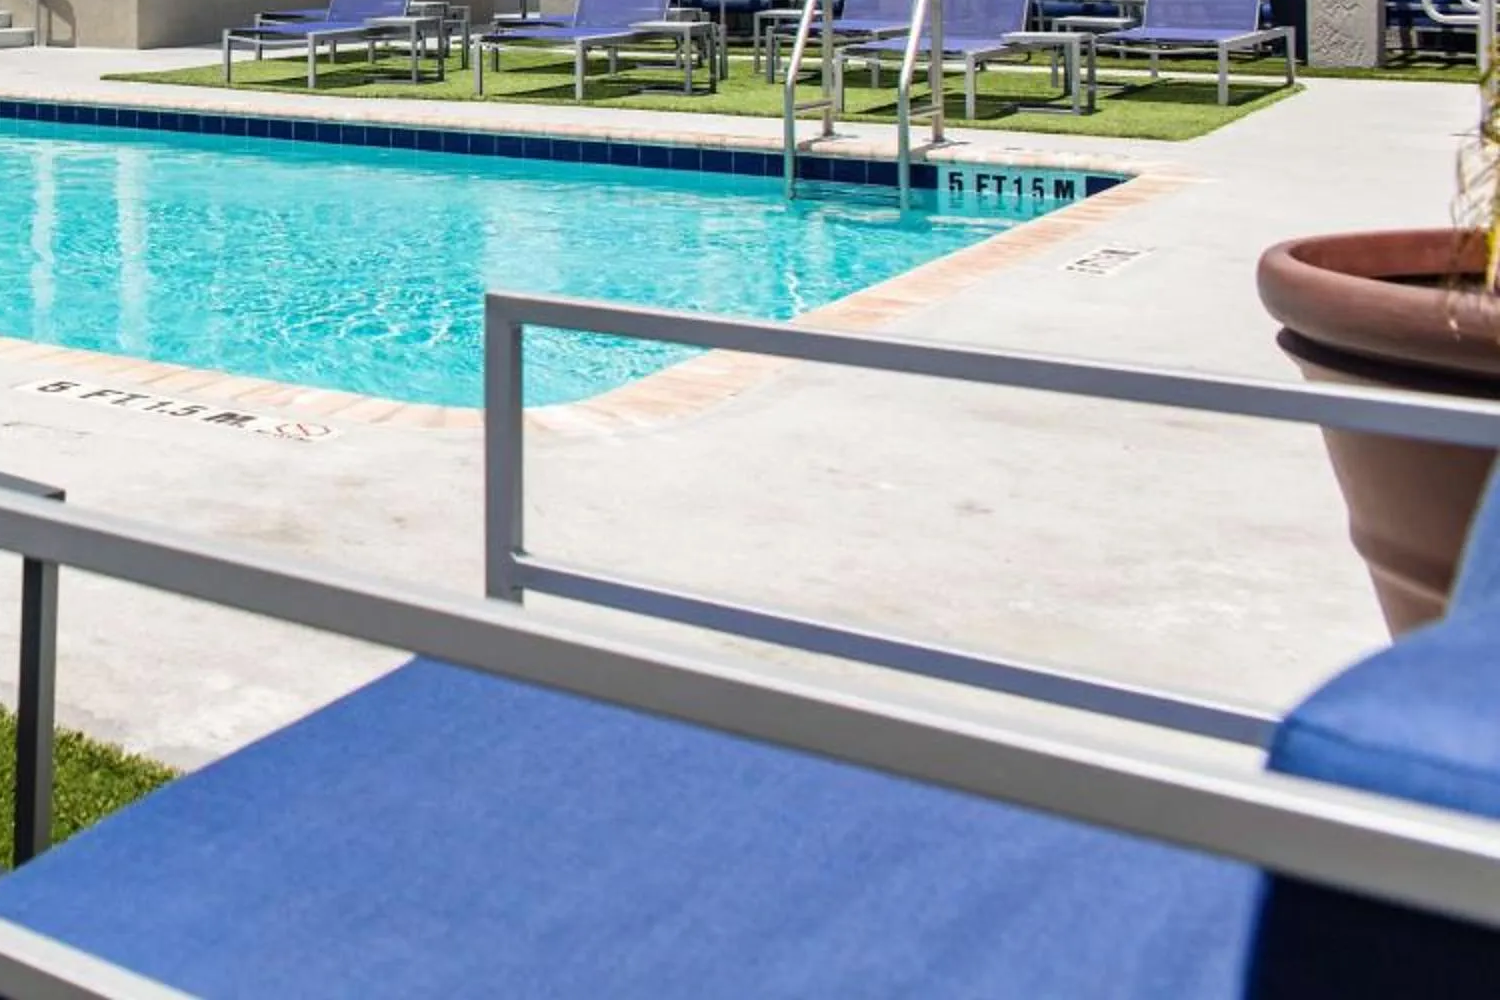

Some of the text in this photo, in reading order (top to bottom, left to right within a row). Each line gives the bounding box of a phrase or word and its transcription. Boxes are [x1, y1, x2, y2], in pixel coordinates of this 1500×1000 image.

[975, 174, 1007, 195] FT
[1053, 179, 1075, 199] M
[79, 389, 151, 405] FT
